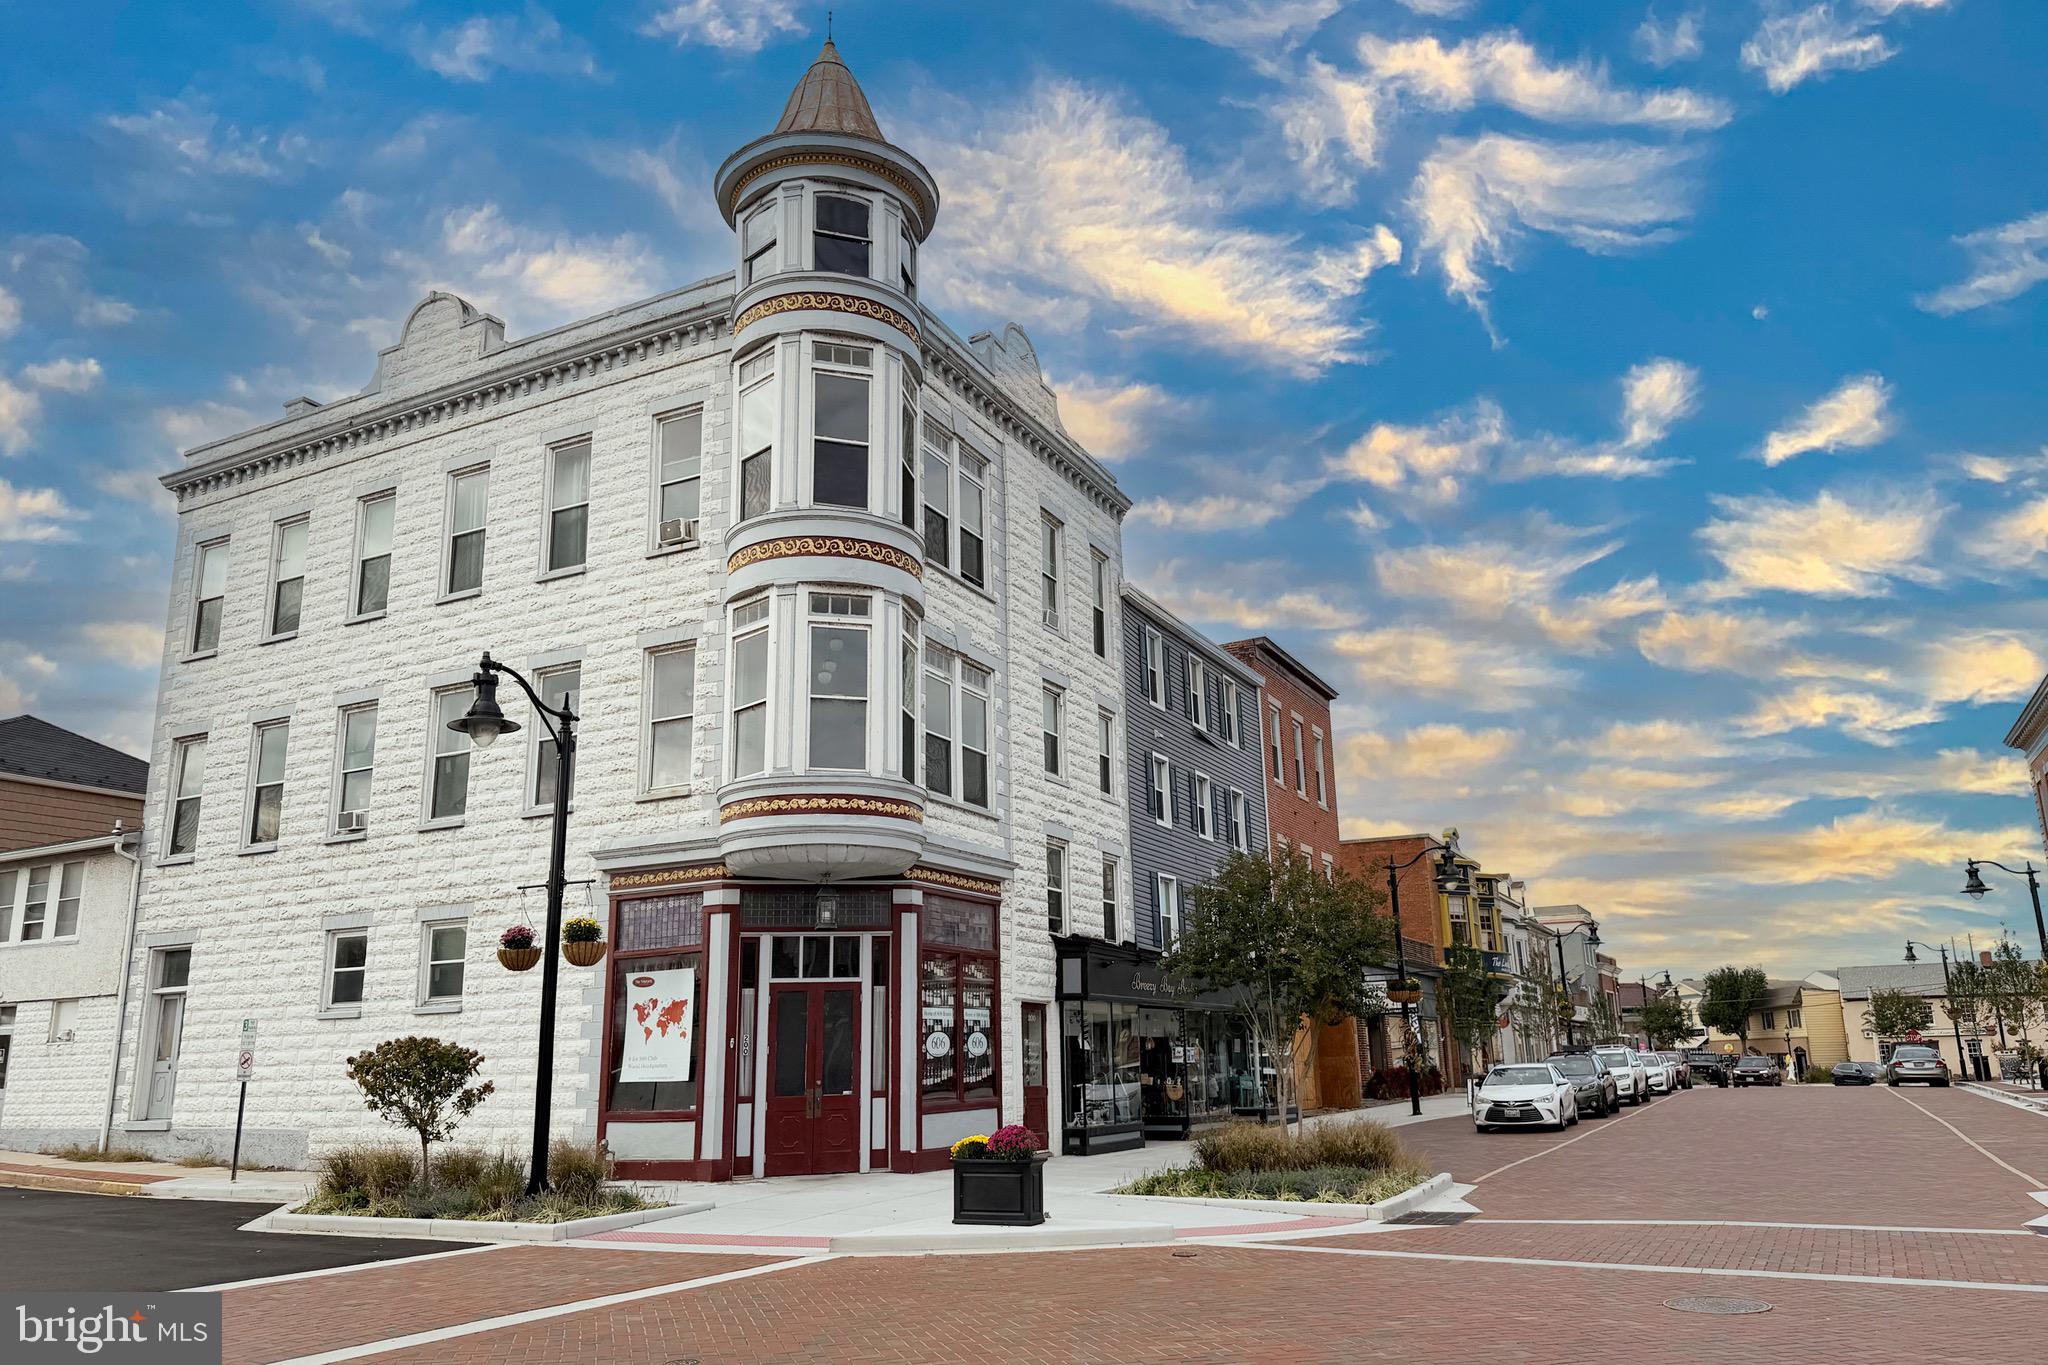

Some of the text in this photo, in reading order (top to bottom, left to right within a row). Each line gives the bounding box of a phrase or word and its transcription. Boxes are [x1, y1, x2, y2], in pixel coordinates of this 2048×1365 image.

[1131, 972, 1157, 997] Breezy
[1160, 975, 1175, 998] Bay
[931, 1036, 946, 1050] 606
[971, 1036, 984, 1049] 606
[1904, 1034, 1921, 1043] STOP
